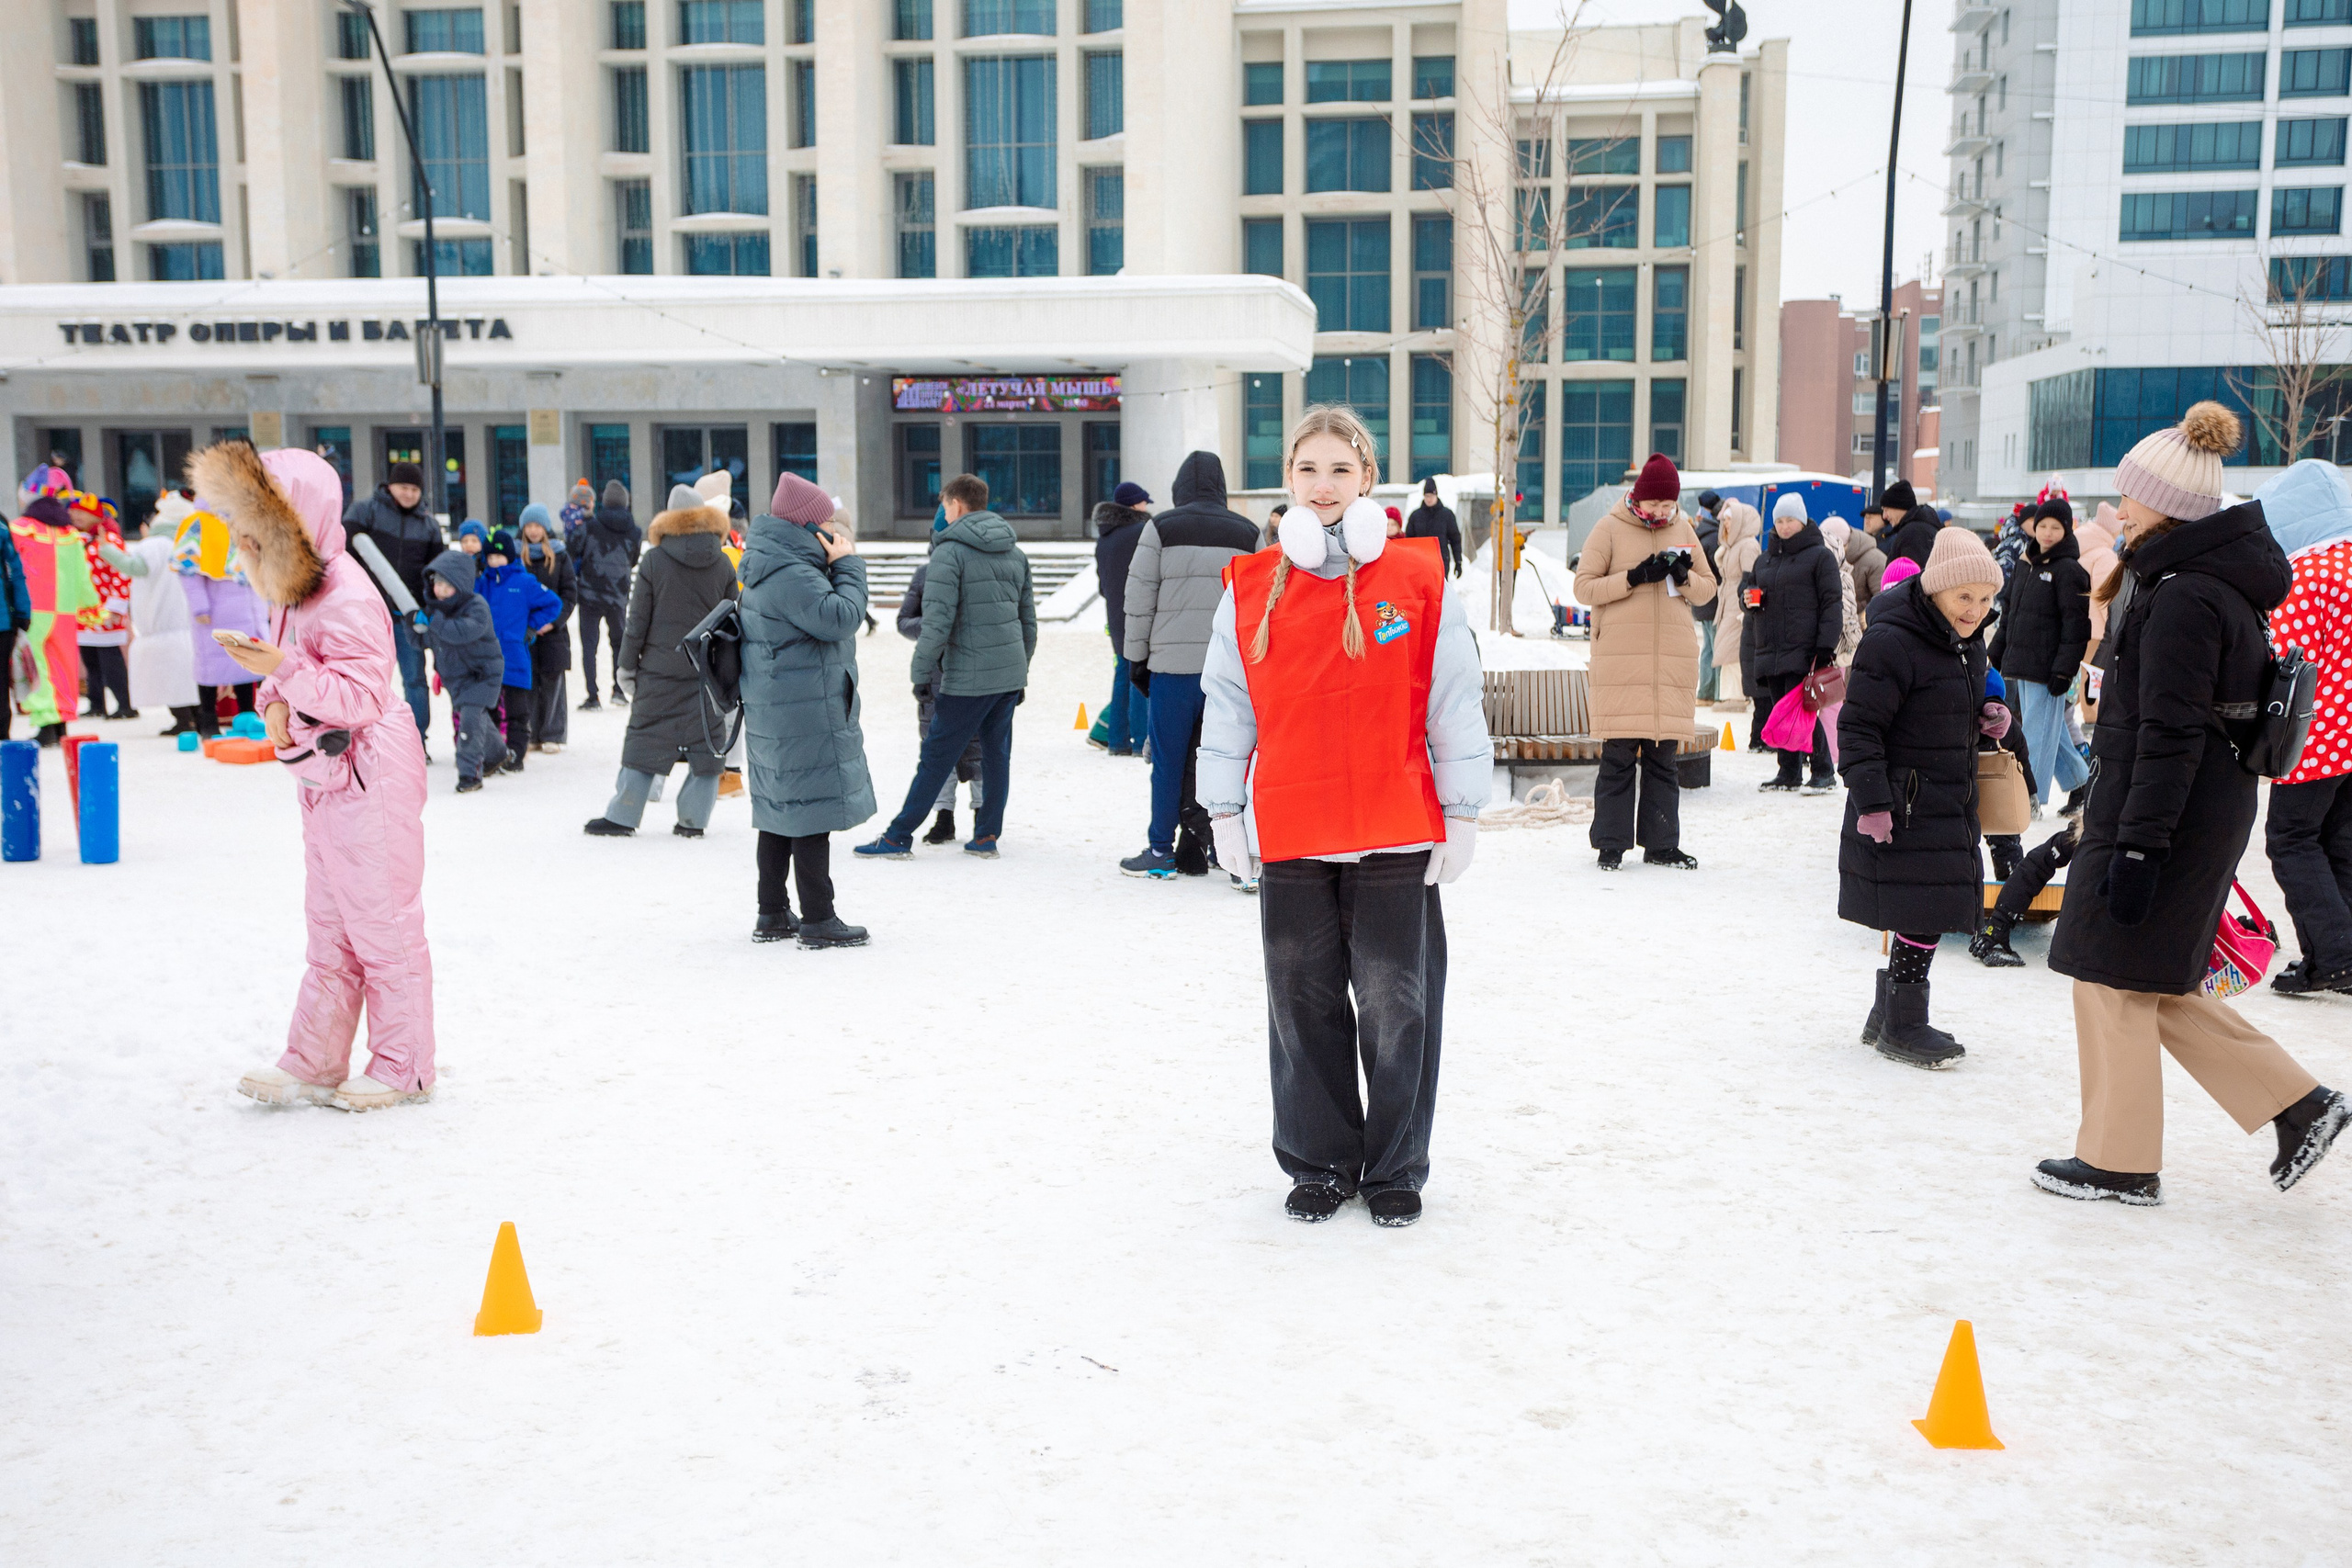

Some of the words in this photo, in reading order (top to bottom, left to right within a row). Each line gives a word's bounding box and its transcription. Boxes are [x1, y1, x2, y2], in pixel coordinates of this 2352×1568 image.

[59, 323, 176, 344] ТЕАТР
[189, 321, 317, 343] ОПЕРЫ
[329, 321, 350, 341] И
